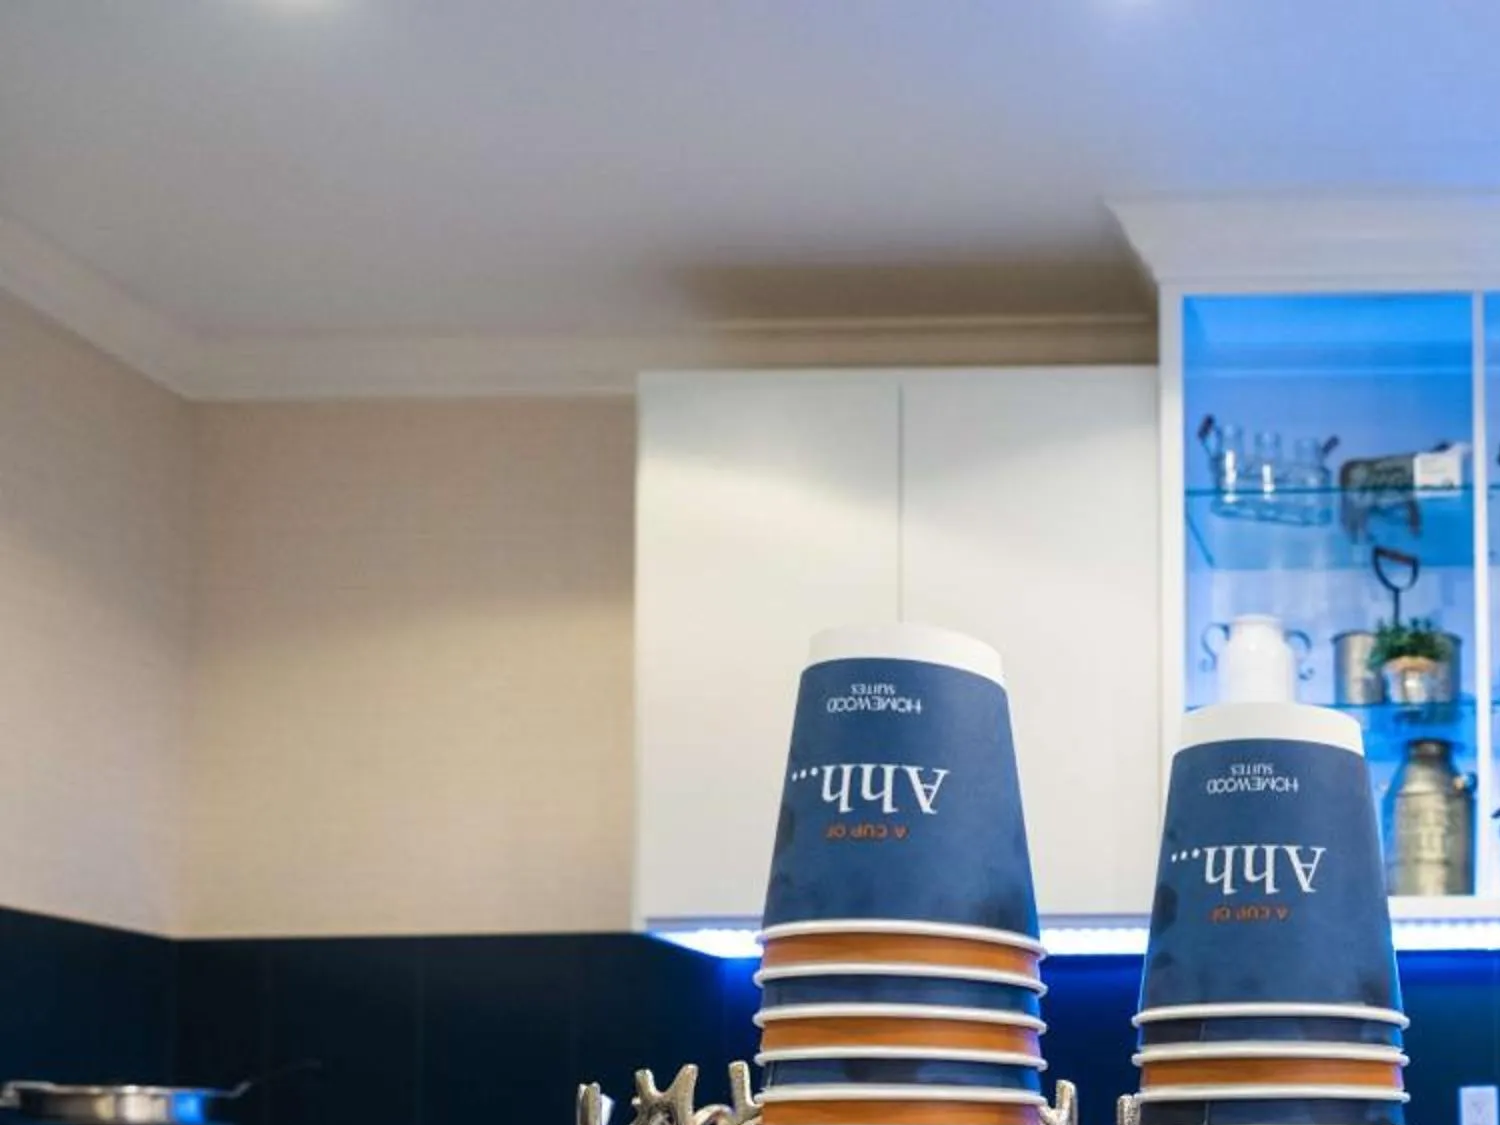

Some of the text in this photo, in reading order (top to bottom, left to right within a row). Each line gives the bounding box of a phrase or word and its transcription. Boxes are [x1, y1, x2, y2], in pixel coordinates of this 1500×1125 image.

[851, 683, 896, 696] SUITES
[827, 697, 923, 714] HOMEWOOD
[1230, 763, 1273, 776] SUITES
[791, 763, 950, 815] Ahh...
[1206, 777, 1299, 795] HOMEWOOD
[827, 824, 908, 840] A CUP OF
[1171, 844, 1327, 895] Ahh...
[1236, 905, 1270, 921] CUP
[1276, 905, 1289, 921] A
